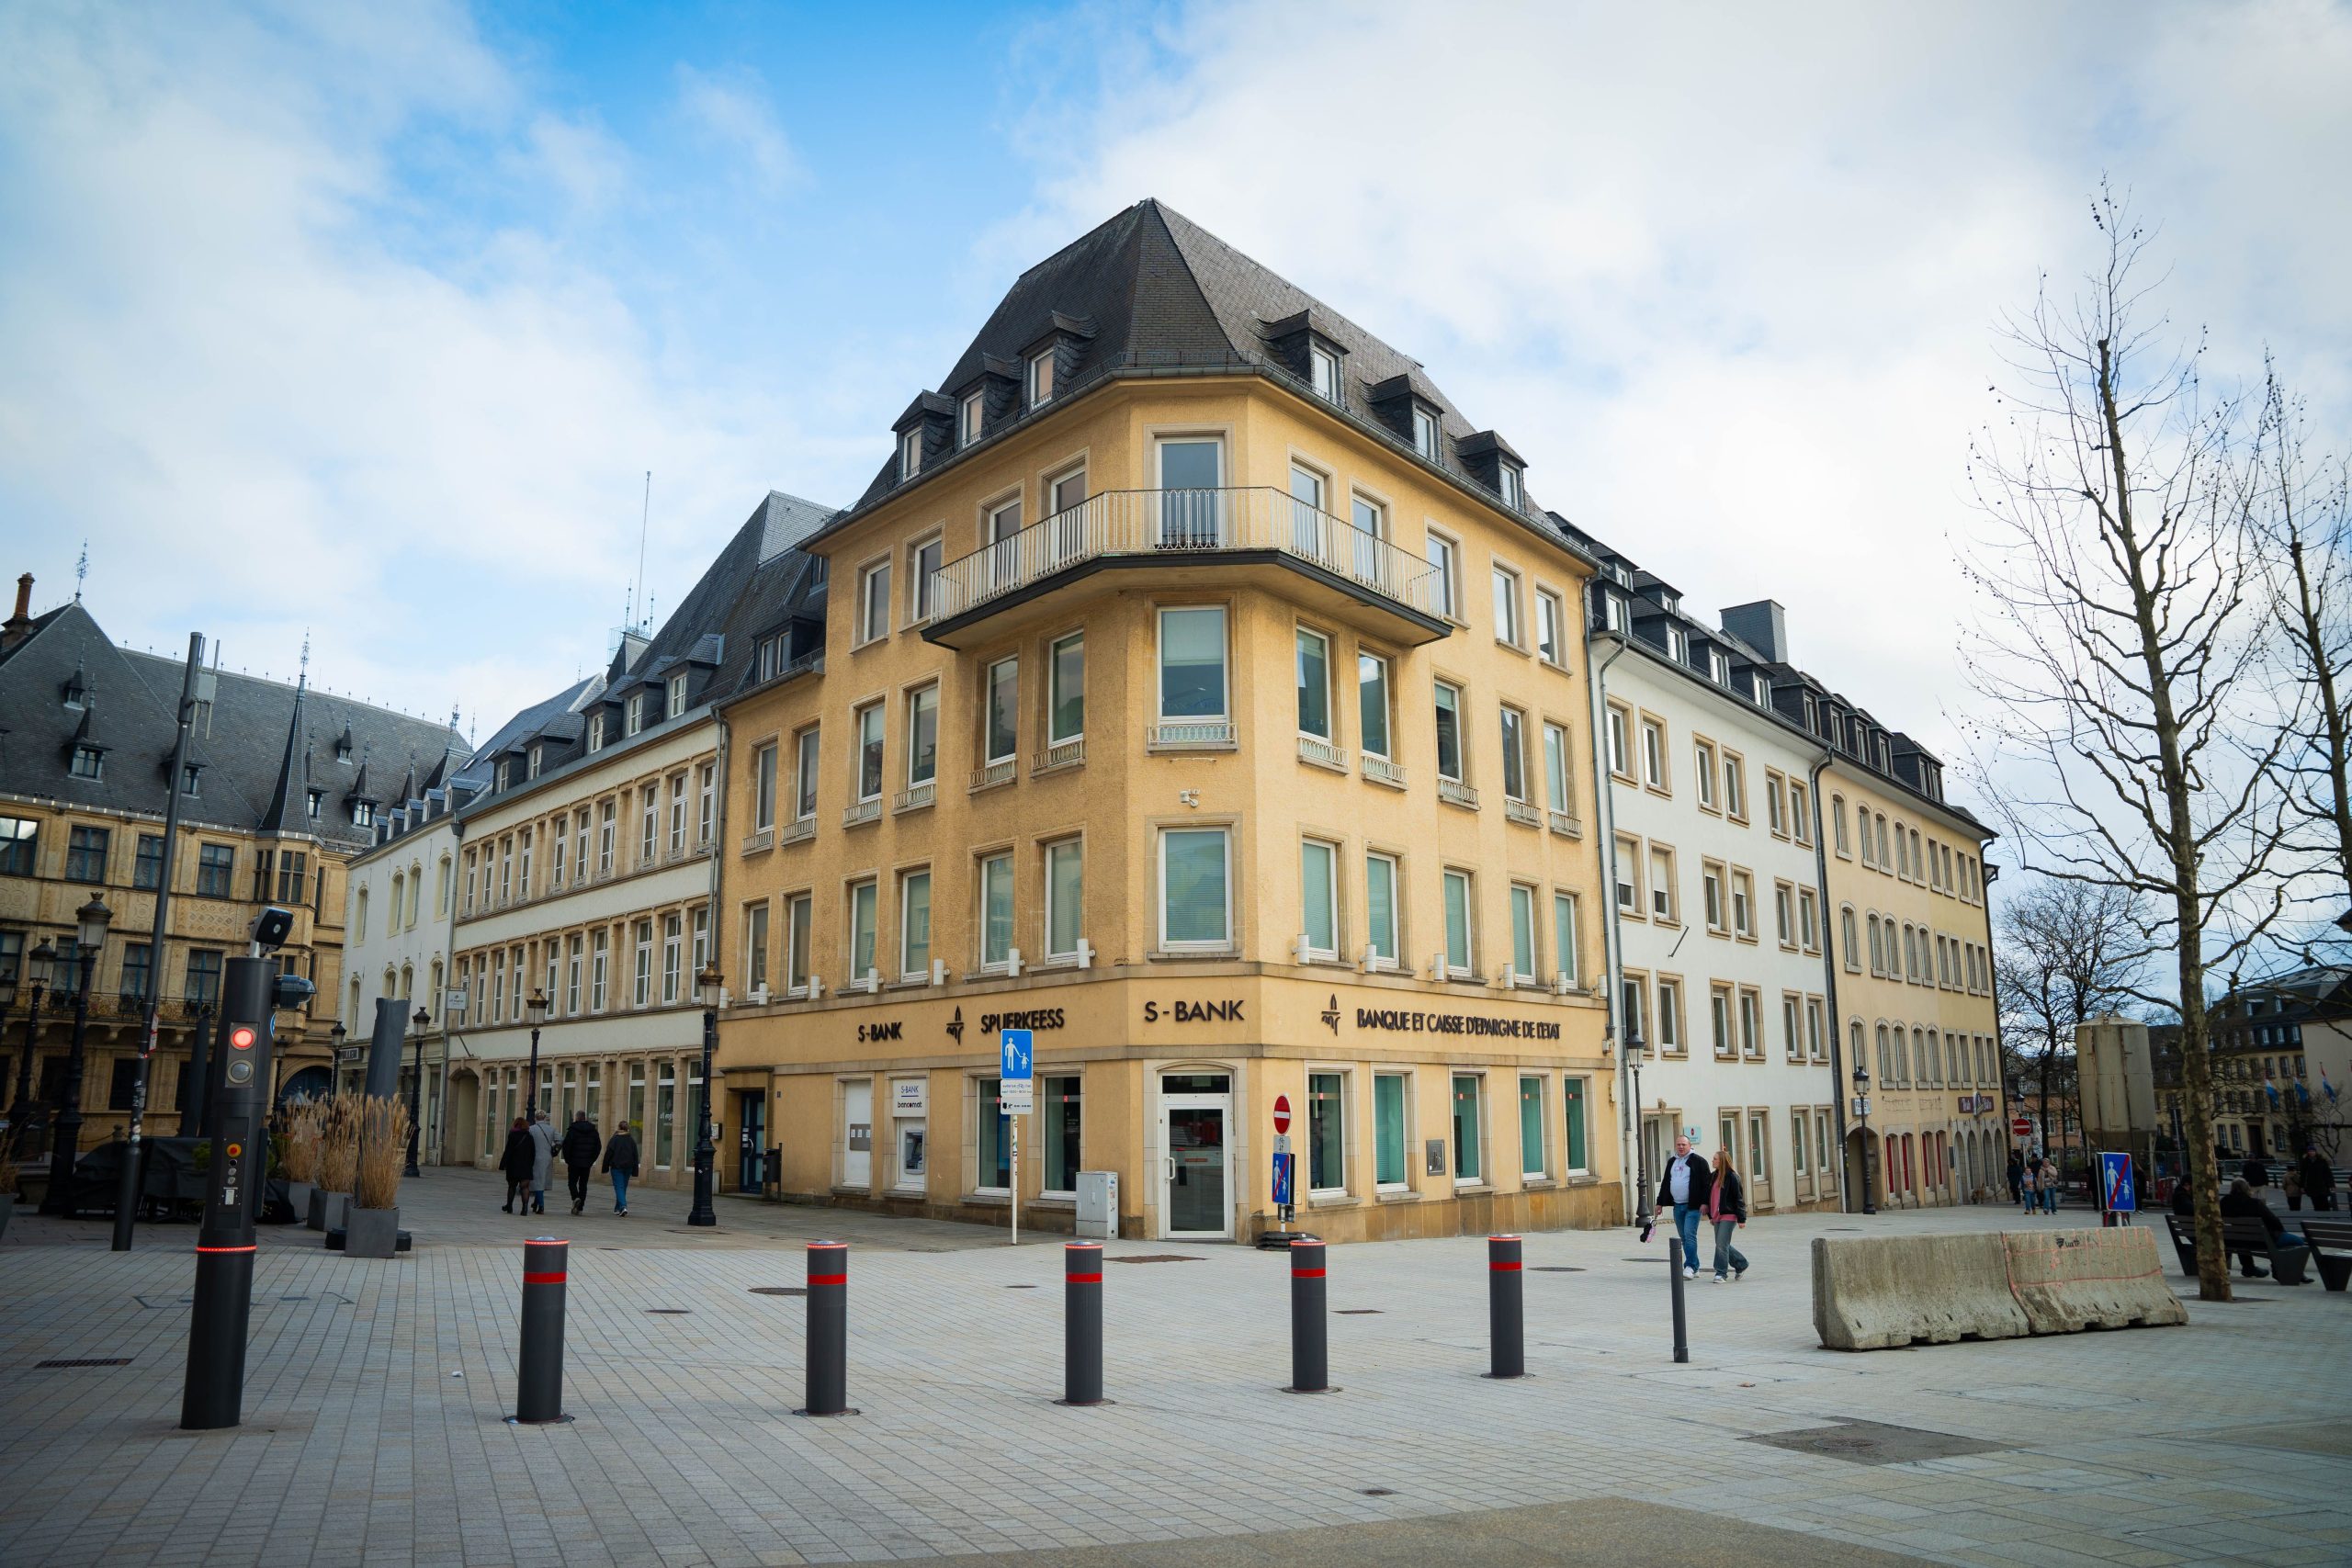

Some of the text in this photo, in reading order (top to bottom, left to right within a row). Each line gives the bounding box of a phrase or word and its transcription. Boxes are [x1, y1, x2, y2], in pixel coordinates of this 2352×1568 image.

[857, 1021, 902, 1043] S-BANK
[980, 1009, 1064, 1033] SPUERKEESS
[1357, 1009, 1561, 1039] BANQUE ET CAISSE D'EPARGNE DE L'ETAT
[900, 1085, 919, 1094] S-BANK
